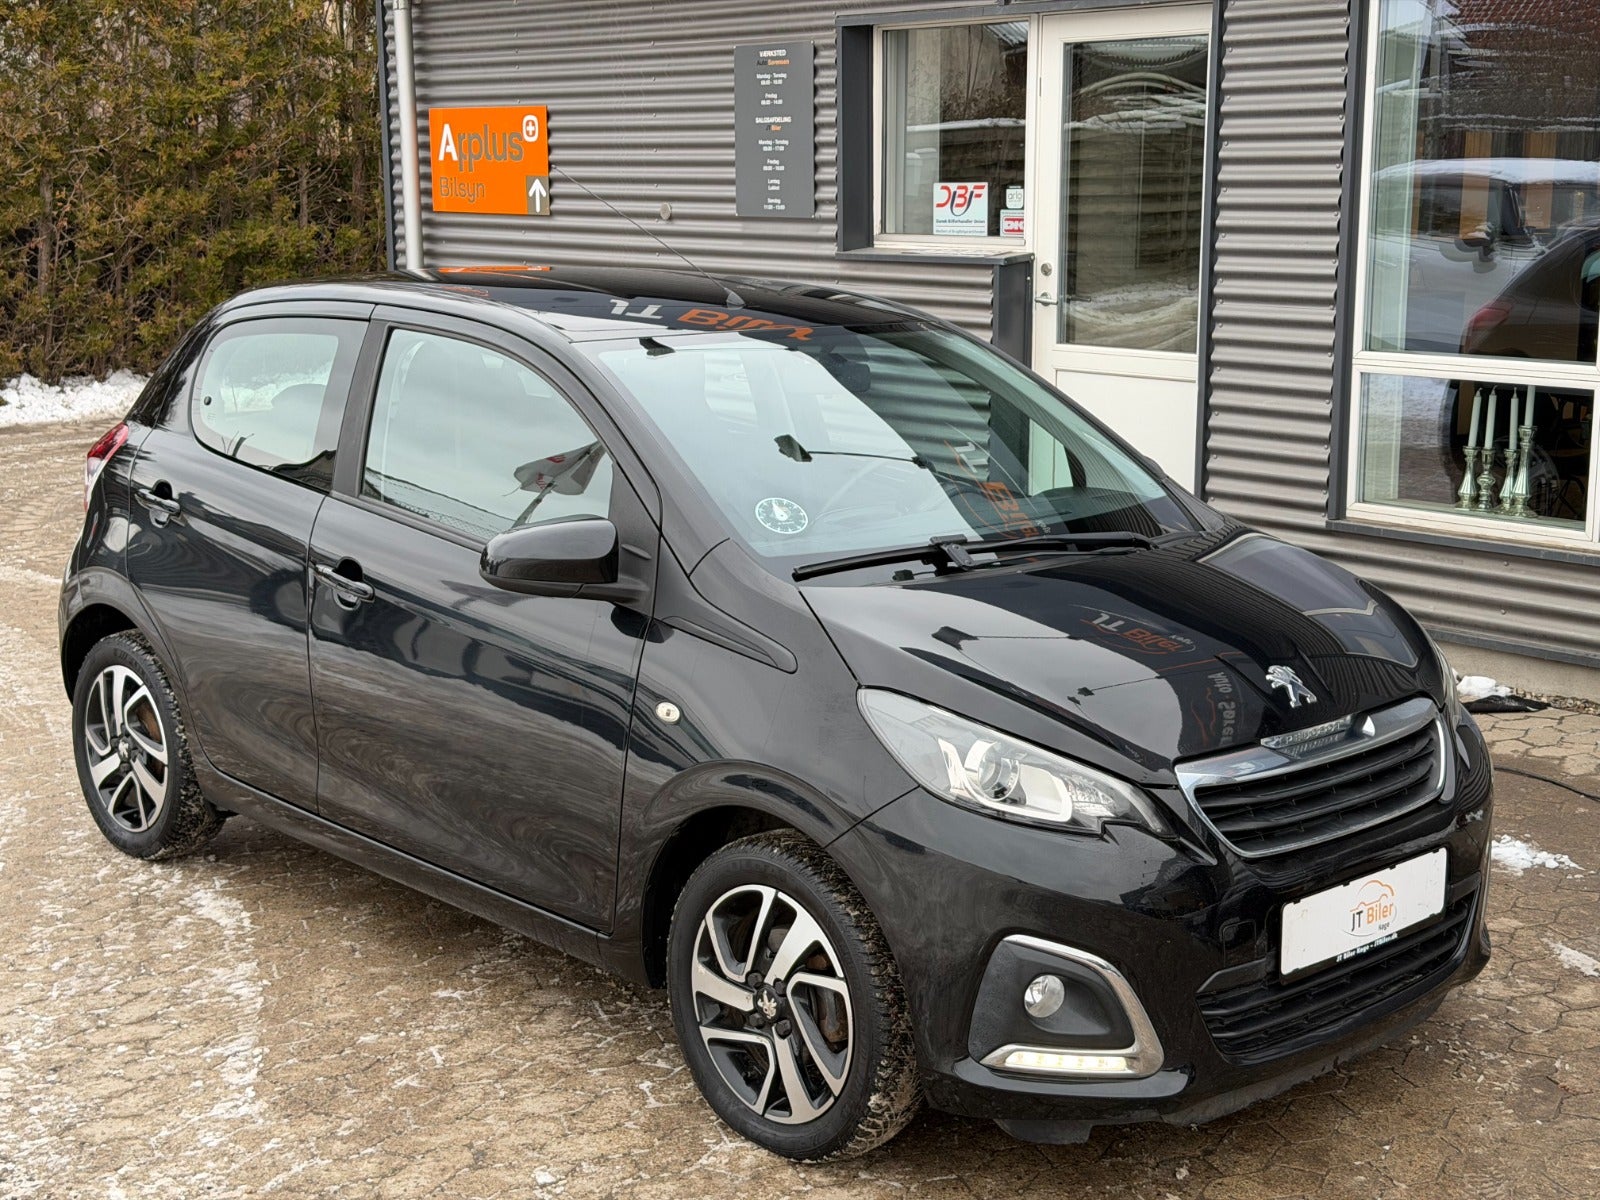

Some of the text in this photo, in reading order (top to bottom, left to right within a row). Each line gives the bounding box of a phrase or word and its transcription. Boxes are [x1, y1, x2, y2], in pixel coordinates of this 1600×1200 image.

[438, 123, 524, 172] Arplus
[439, 176, 485, 203] Bilsyn
[1351, 902, 1394, 932] JT Biler
